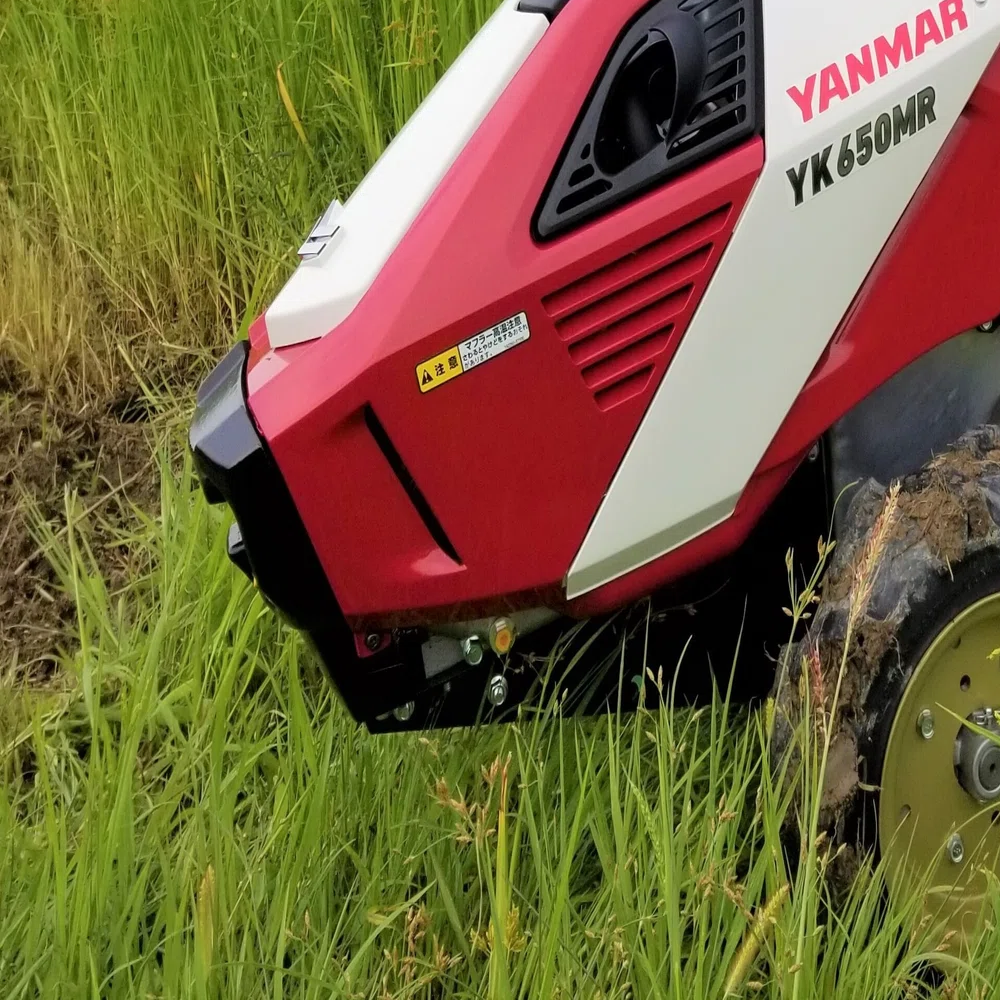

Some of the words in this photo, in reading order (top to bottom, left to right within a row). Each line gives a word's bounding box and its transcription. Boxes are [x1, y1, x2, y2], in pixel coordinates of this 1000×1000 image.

[785, 86, 936, 207] YK650MR
[464, 316, 522, 350] マフラー高温注意
[434, 355, 459, 377] 注意
